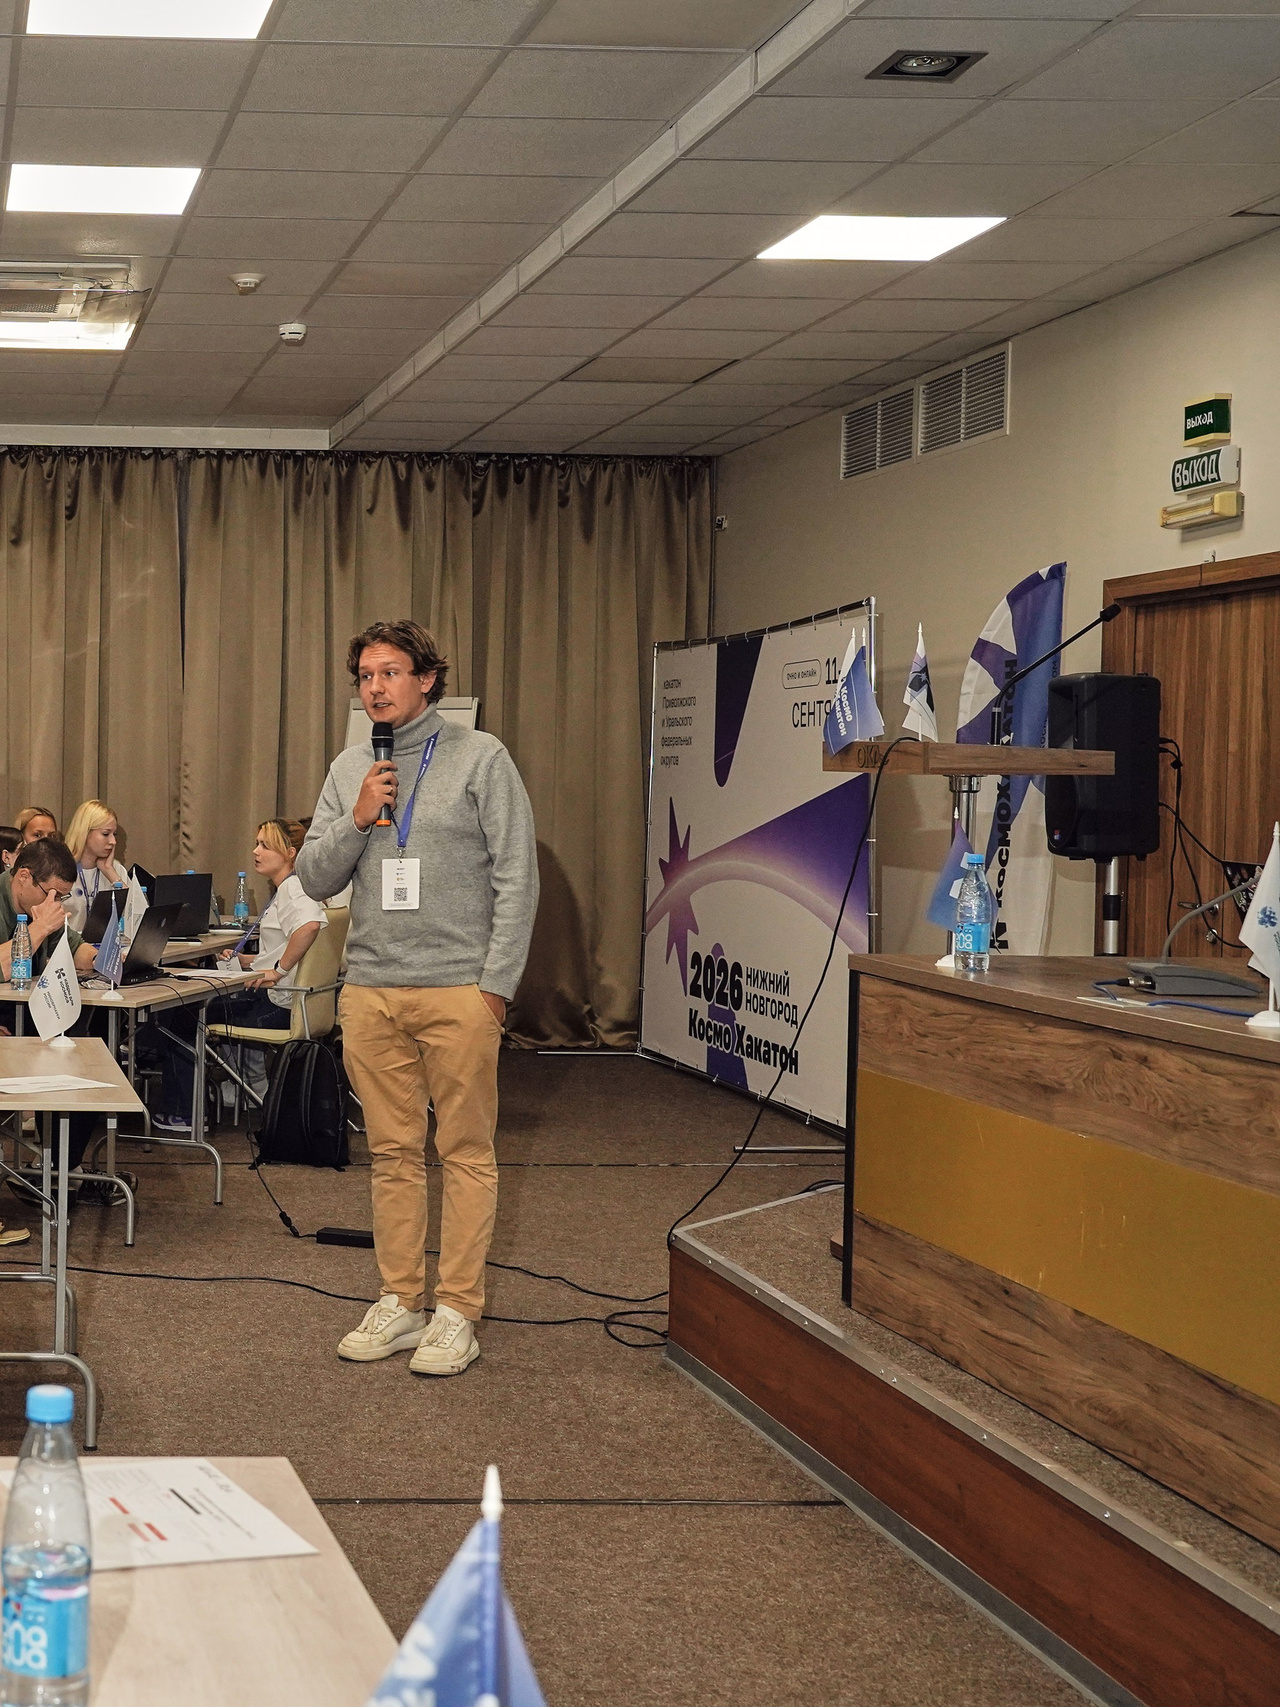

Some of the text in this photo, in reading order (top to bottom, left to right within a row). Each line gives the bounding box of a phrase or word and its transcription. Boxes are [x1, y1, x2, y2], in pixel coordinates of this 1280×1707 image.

[1174, 453, 1218, 488] ВЫХОД
[792, 699, 832, 728] СЕНТЯ
[841, 685, 853, 722] Космо
[688, 951, 744, 1012] 2026
[745, 966, 790, 997] НИЖНИЙ
[745, 991, 799, 1030] НОВГОРОД
[688, 1008, 799, 1076] Космо Хакатон
